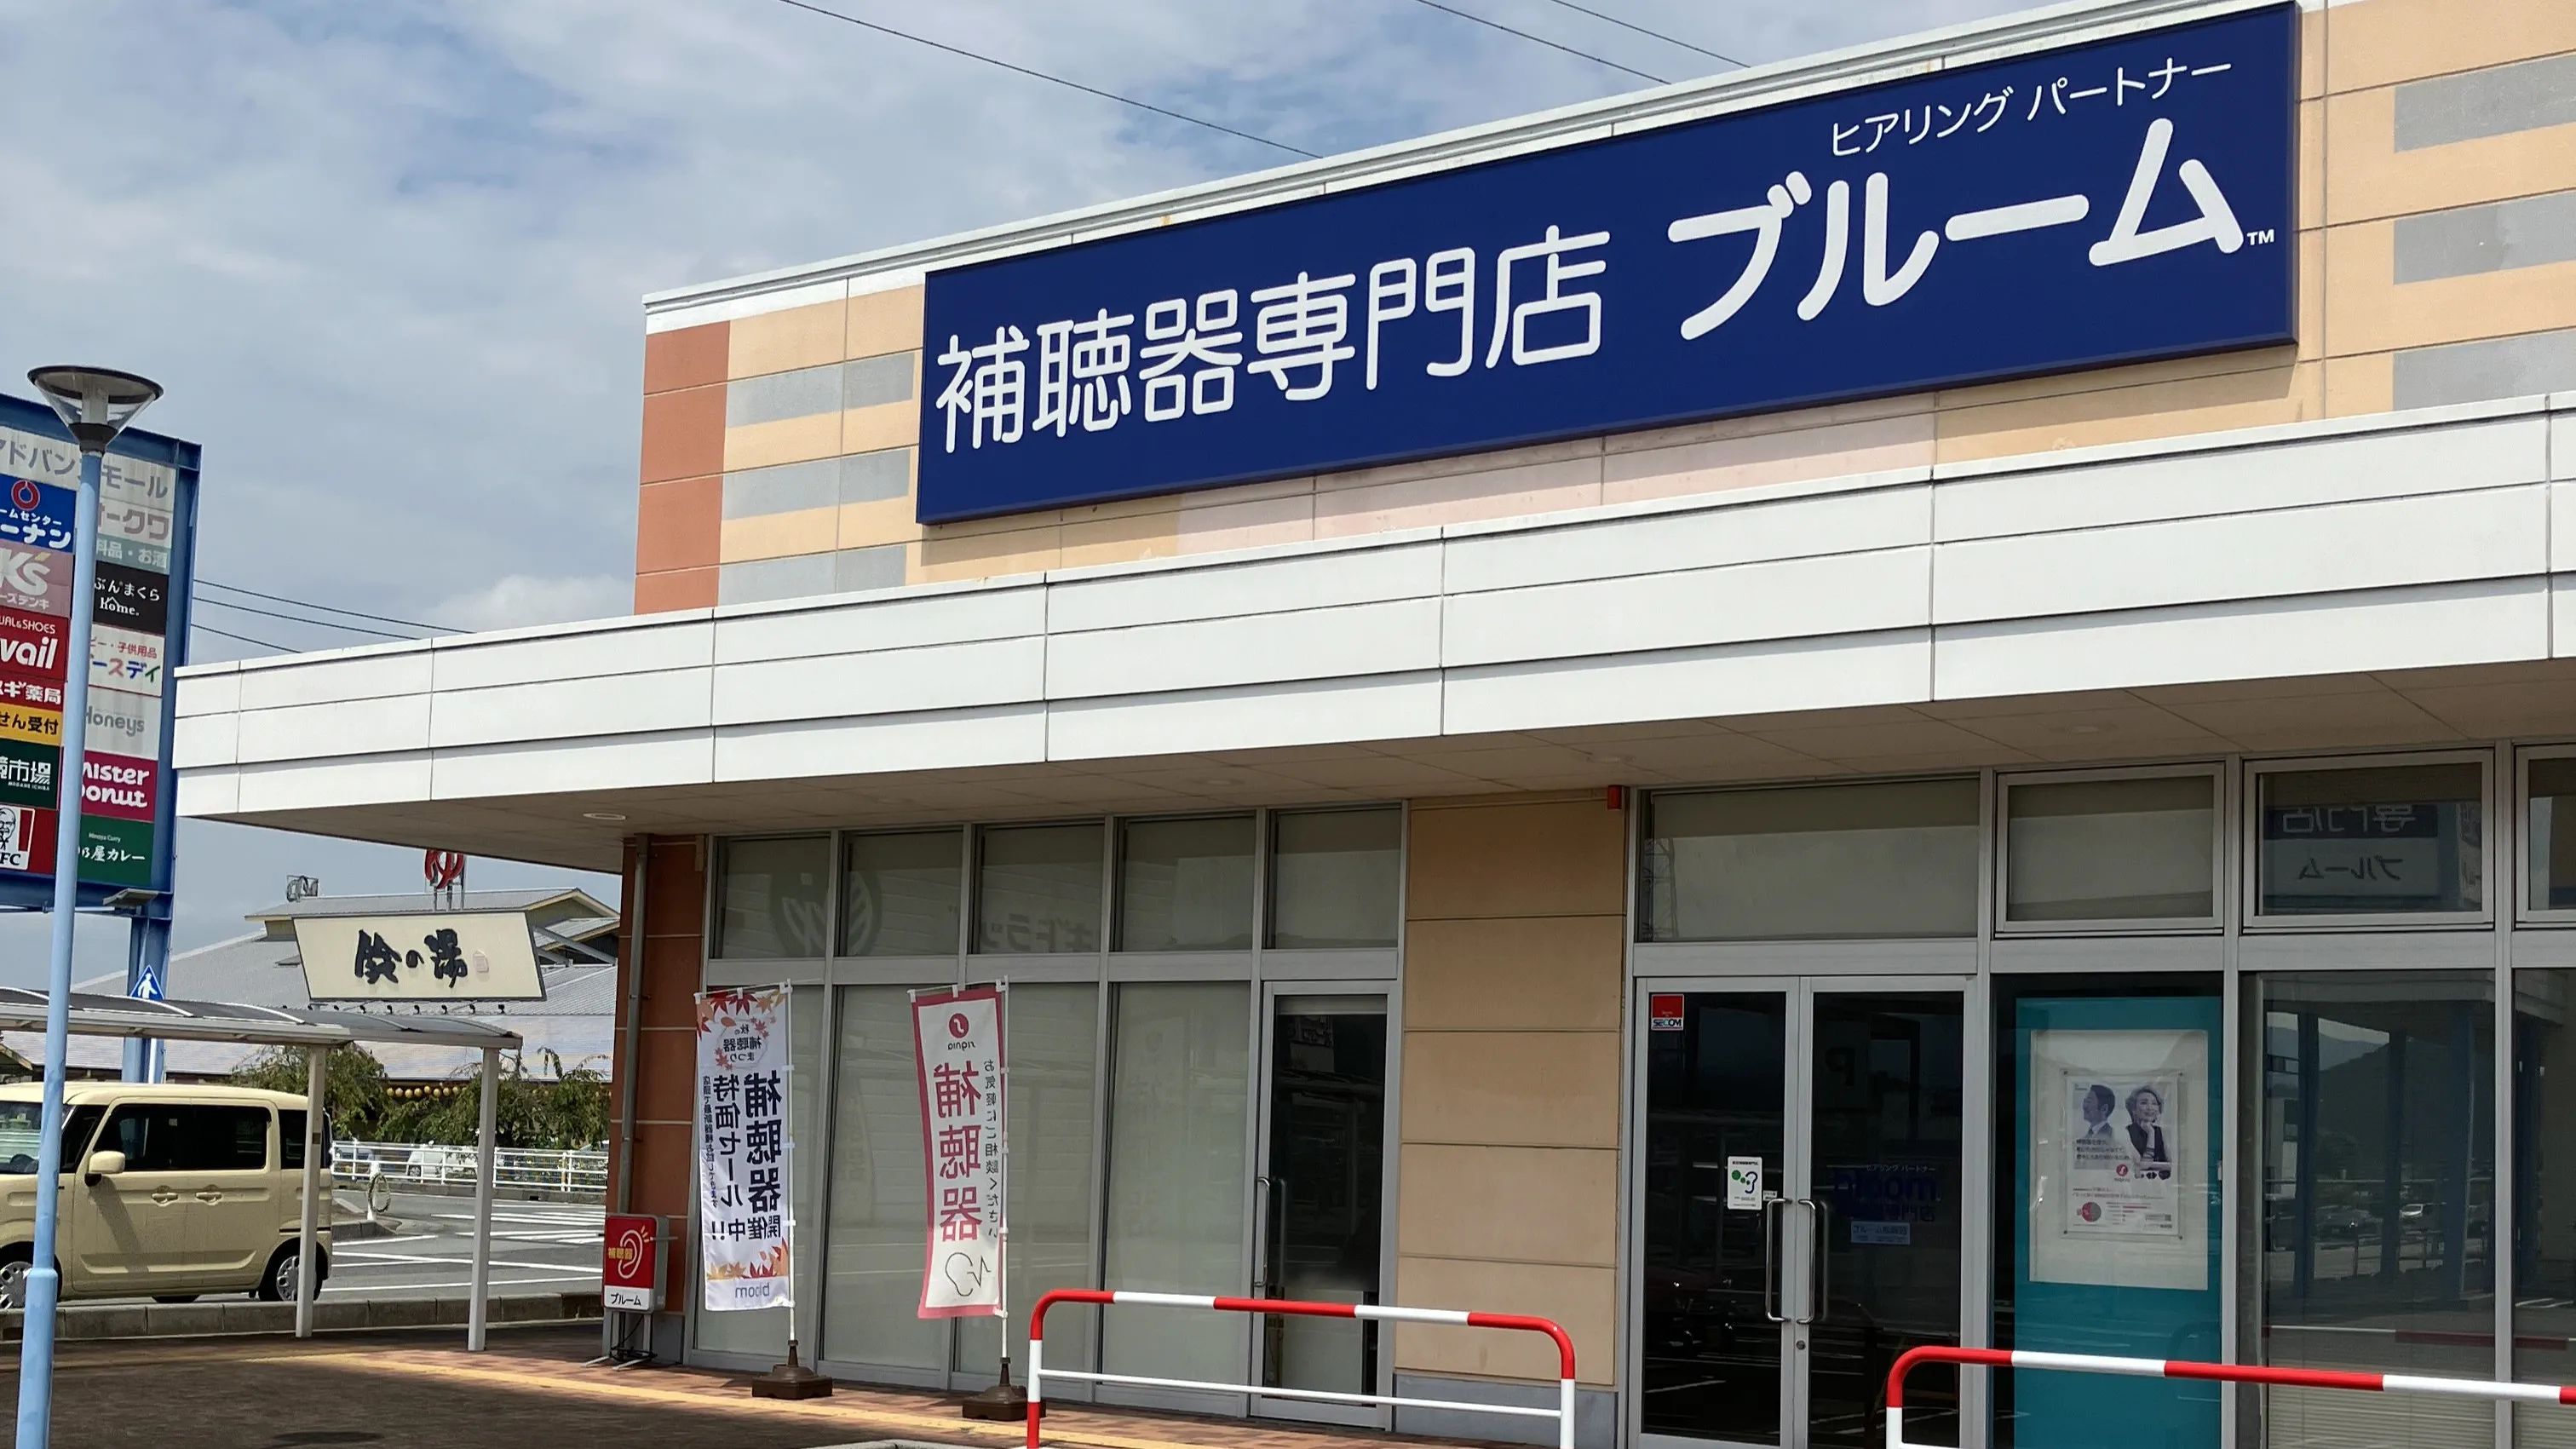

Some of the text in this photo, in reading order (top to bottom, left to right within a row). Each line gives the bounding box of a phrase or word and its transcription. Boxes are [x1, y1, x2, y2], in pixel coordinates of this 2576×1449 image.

[1832, 57, 2232, 157] ヒアリング パートナー
[1667, 118, 2244, 340] ブルーム
[935, 225, 1611, 453] 補聴器専門店
[100, 596, 140, 617] Home.
[90, 655, 161, 683] ースデイ
[0, 681, 62, 705] ギ薬局
[82, 784, 148, 808] onut
[78, 844, 146, 862] 乃屋カレー
[354, 928, 468, 988] 鈴の湯
[1653, 1018, 1682, 1026] SECOM
[611, 1292, 641, 1306] ブルーム
